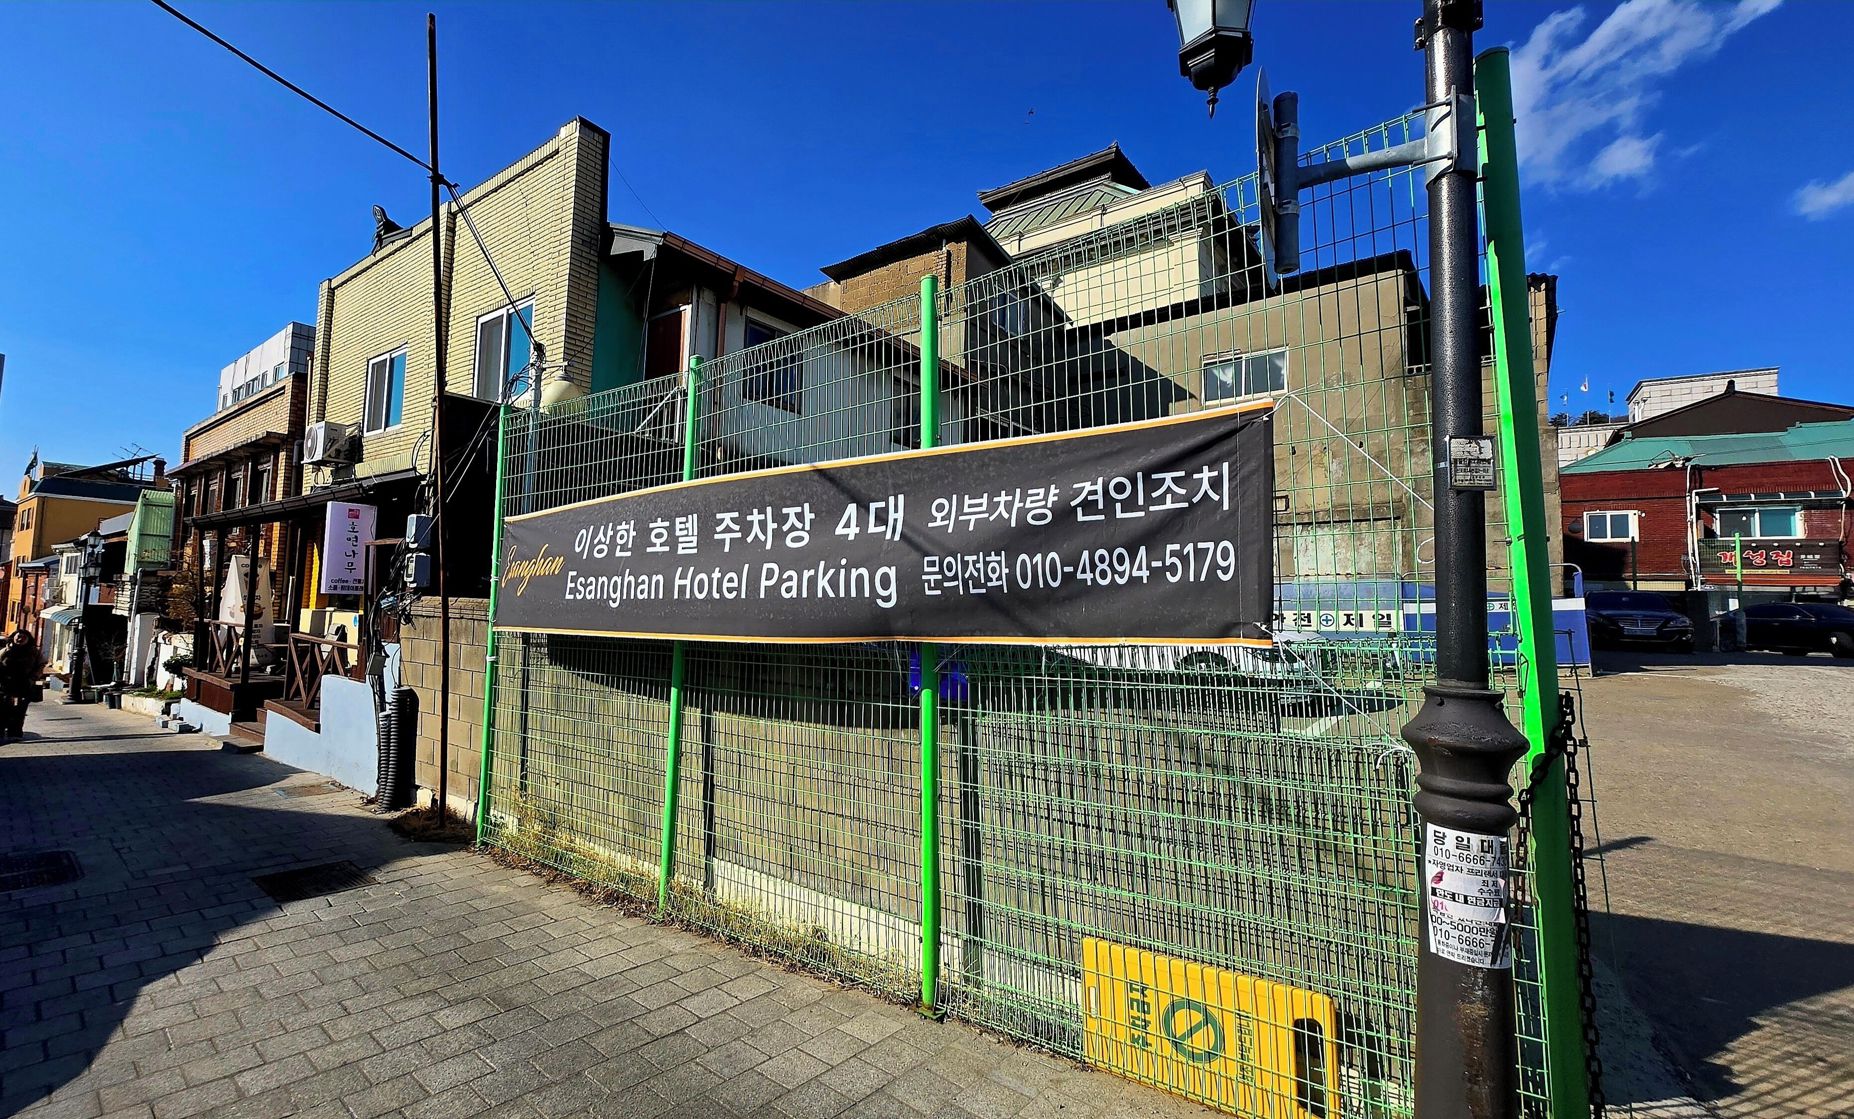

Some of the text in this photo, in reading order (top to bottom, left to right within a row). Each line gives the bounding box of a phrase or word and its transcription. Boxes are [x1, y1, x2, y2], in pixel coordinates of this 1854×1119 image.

[928, 461, 1229, 533] 외부차량 견인조치
[574, 494, 905, 560] 이상한 호텔 주차장 4대
[565, 557, 897, 608] Esanghan Hotel Parking
[921, 540, 1236, 595] 문의전화 010-4894-5179
[1717, 550, 1793, 566] 개성집
[1343, 612, 1392, 628] 제일
